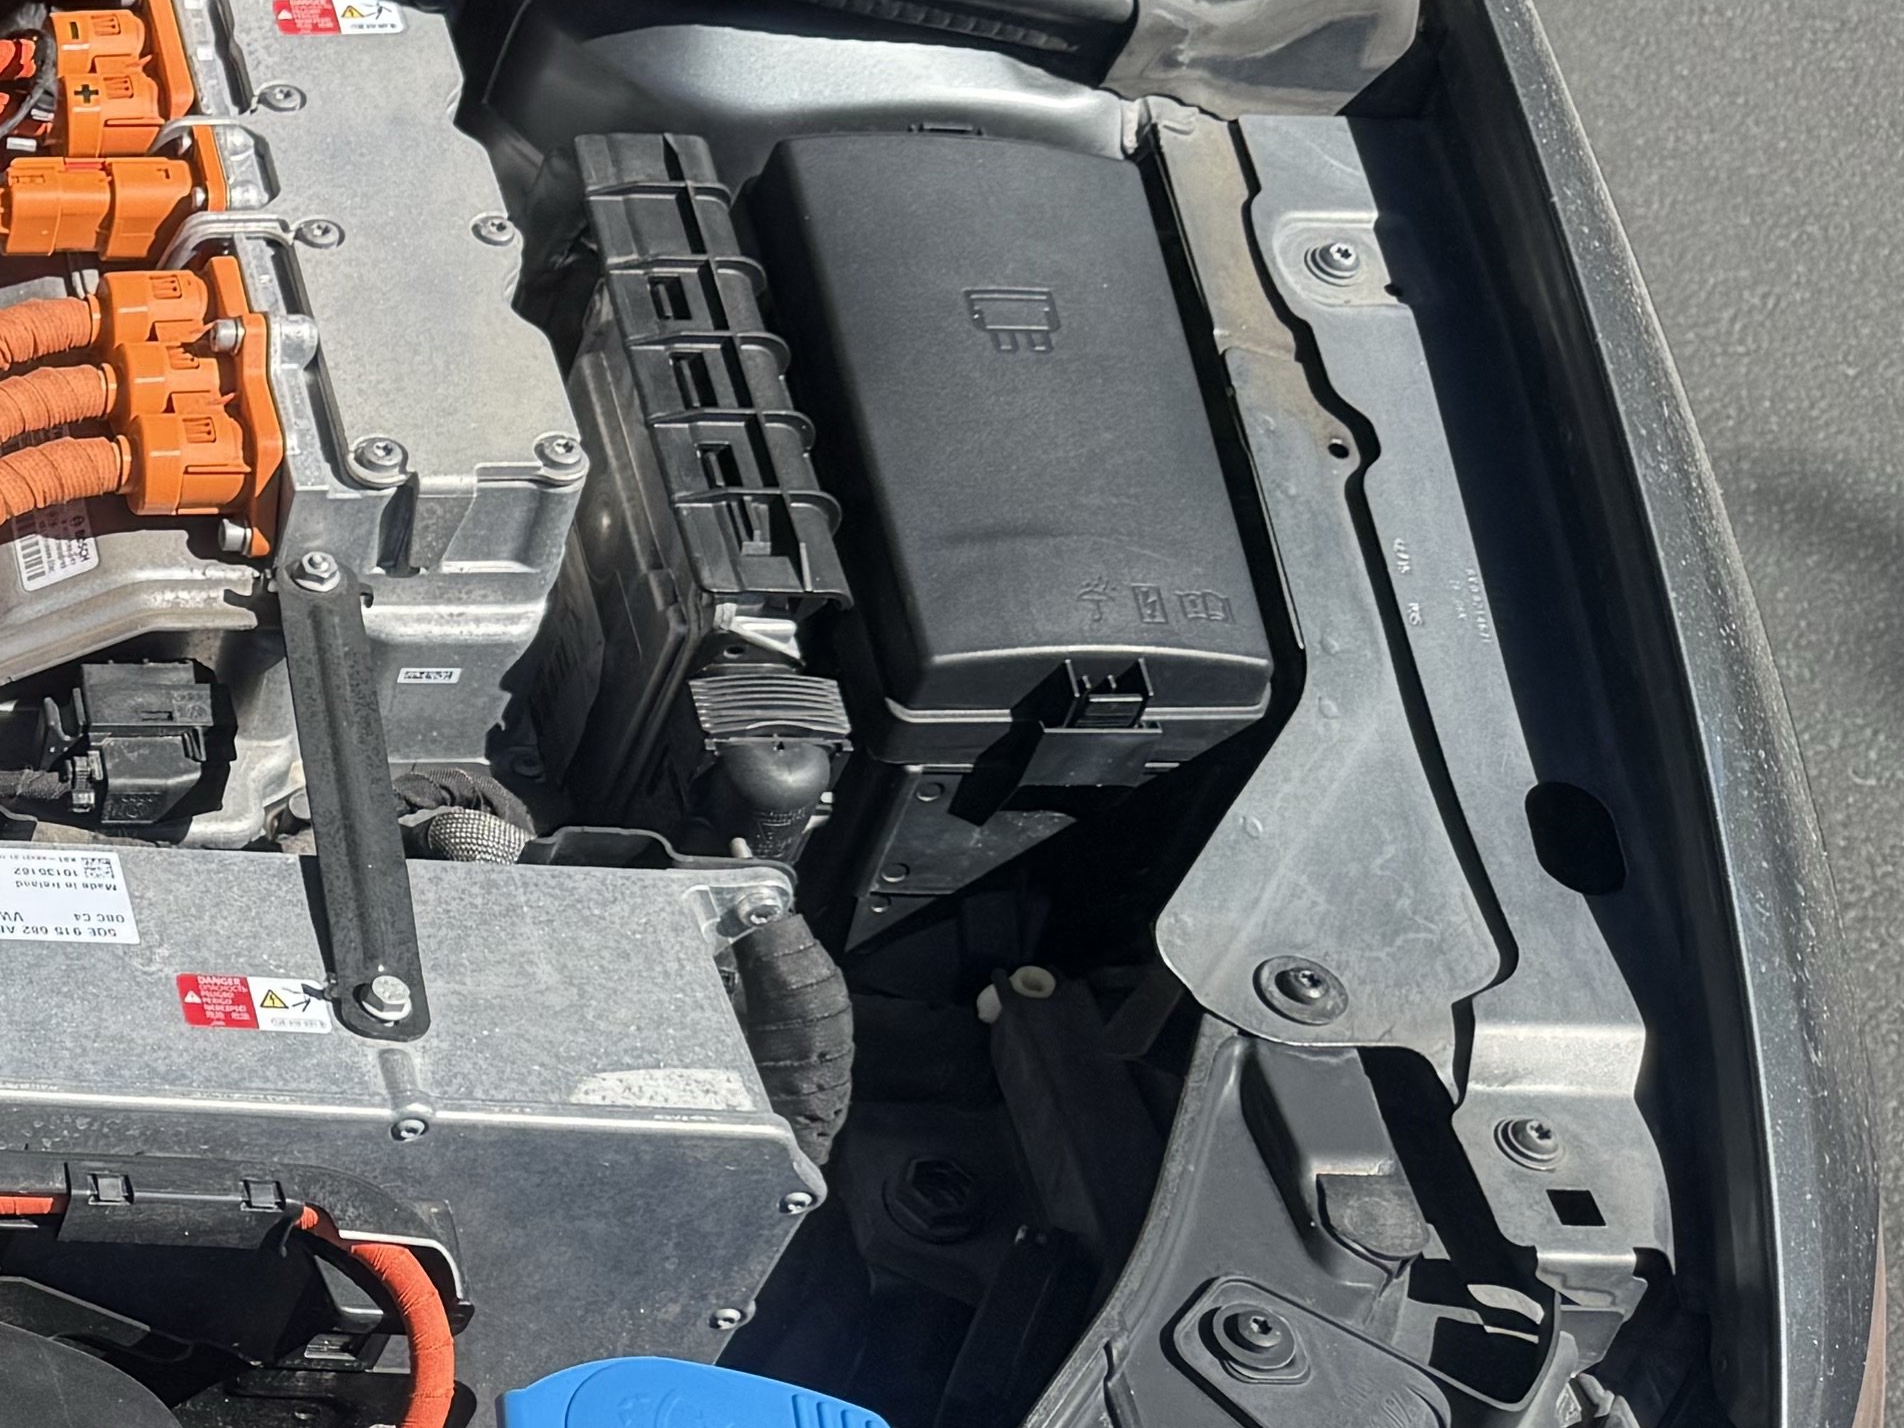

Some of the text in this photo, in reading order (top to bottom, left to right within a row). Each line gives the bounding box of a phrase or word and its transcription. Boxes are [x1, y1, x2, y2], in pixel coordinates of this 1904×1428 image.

[14, 879, 118, 891] Made in Ireland
[72, 912, 125, 924] OBC C4
[54, 926, 82, 937] 915
[197, 975, 241, 986] DANGER
